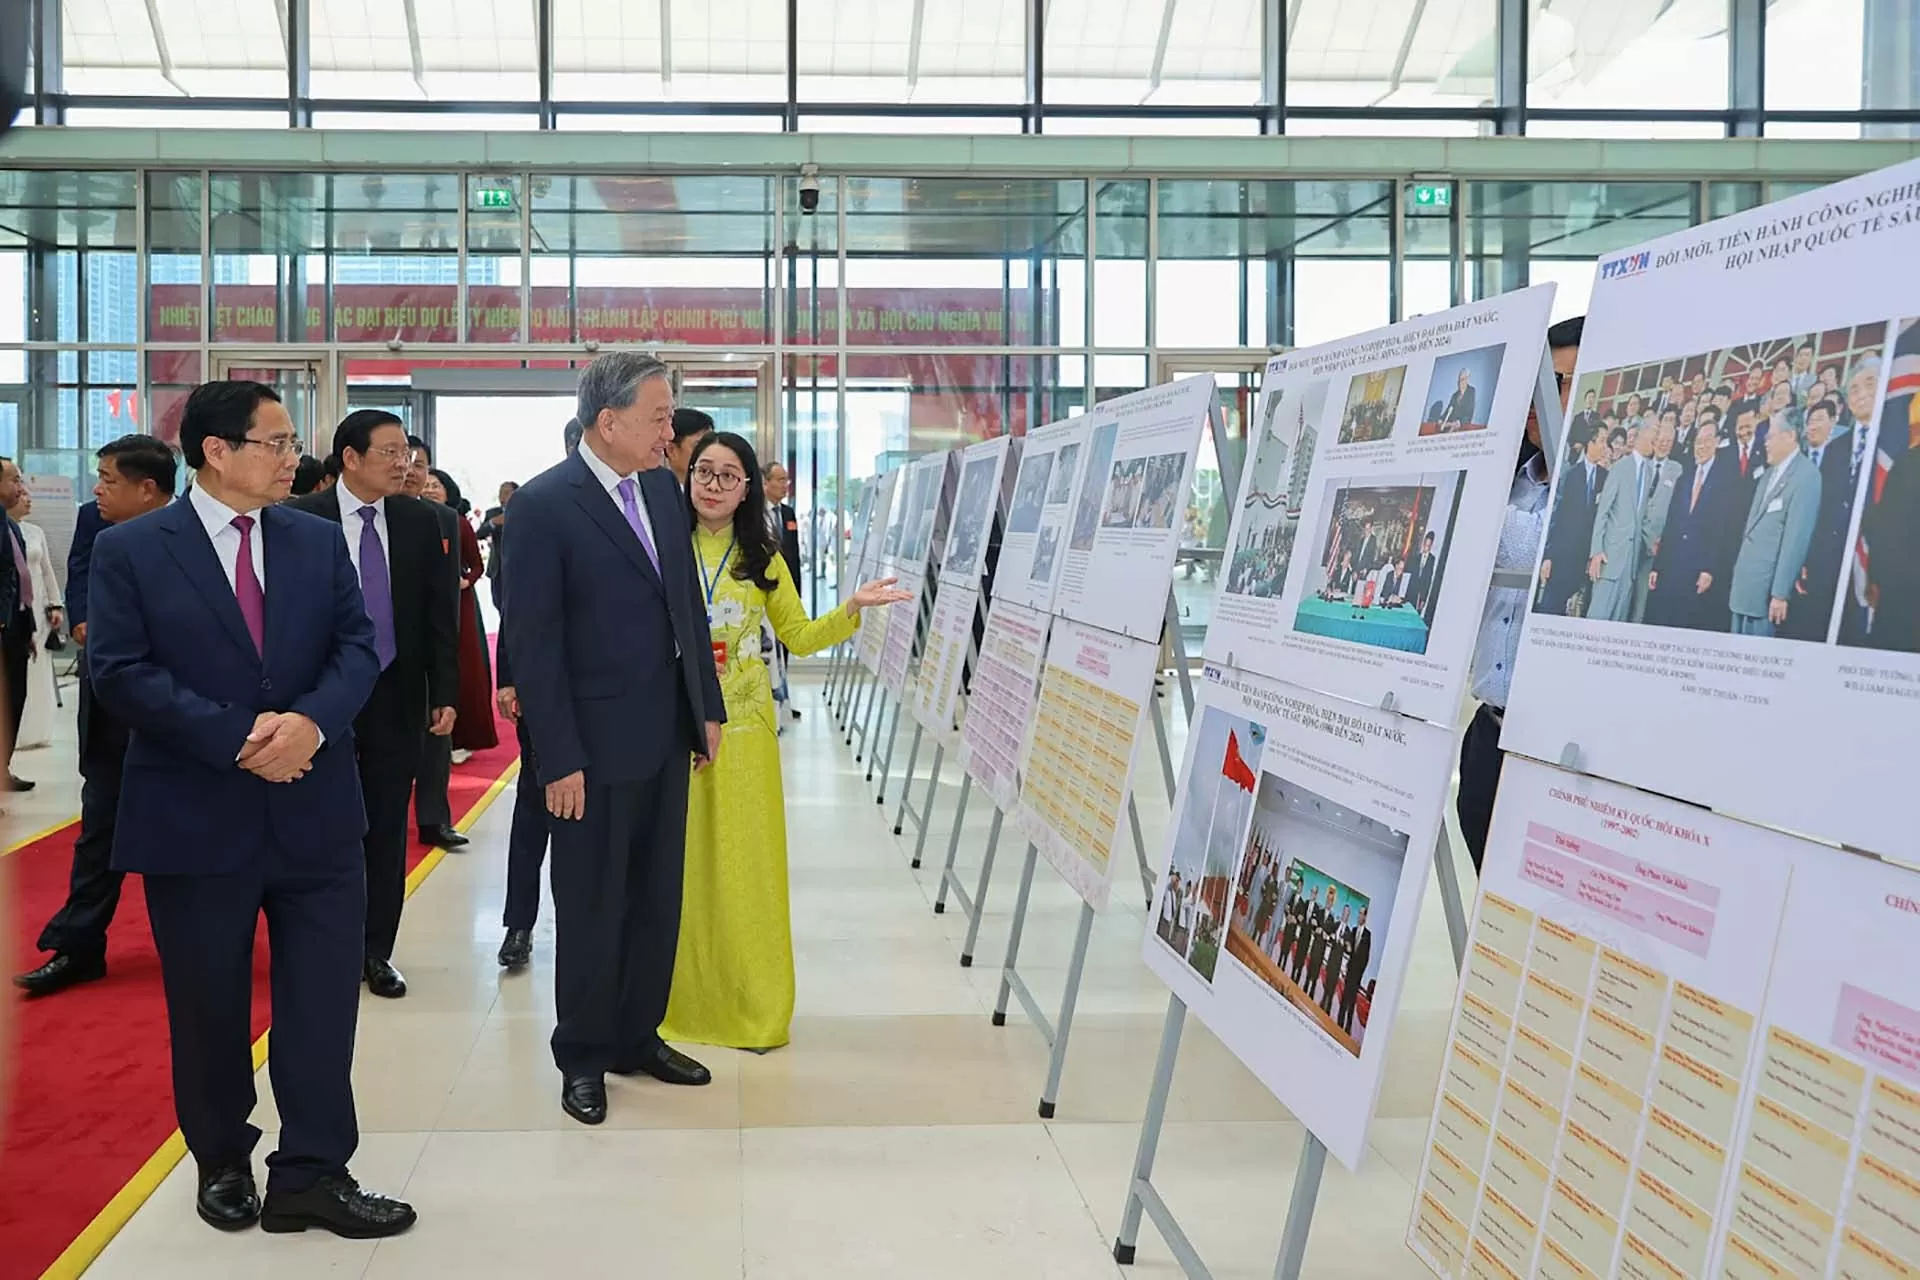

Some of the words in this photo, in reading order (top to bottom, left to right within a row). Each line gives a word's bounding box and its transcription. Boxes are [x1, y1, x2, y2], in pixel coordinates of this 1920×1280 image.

[1719, 228, 1753, 251] TIẾN
[1756, 215, 1802, 242] HÀNH
[1807, 200, 1859, 227] CÔNG
[1725, 250, 1754, 270] HỘI
[1757, 238, 1801, 264] NHẬP
[1804, 222, 1858, 251] QUỐC
[1861, 211, 1886, 236] TẾ
[236, 303, 275, 327] CHÀO
[335, 303, 353, 327] ÁC
[357, 305, 381, 331] ĐẠI
[632, 305, 660, 333] LẬP
[664, 304, 706, 329] CHÍNH
[1702, 833, 1713, 848] X
